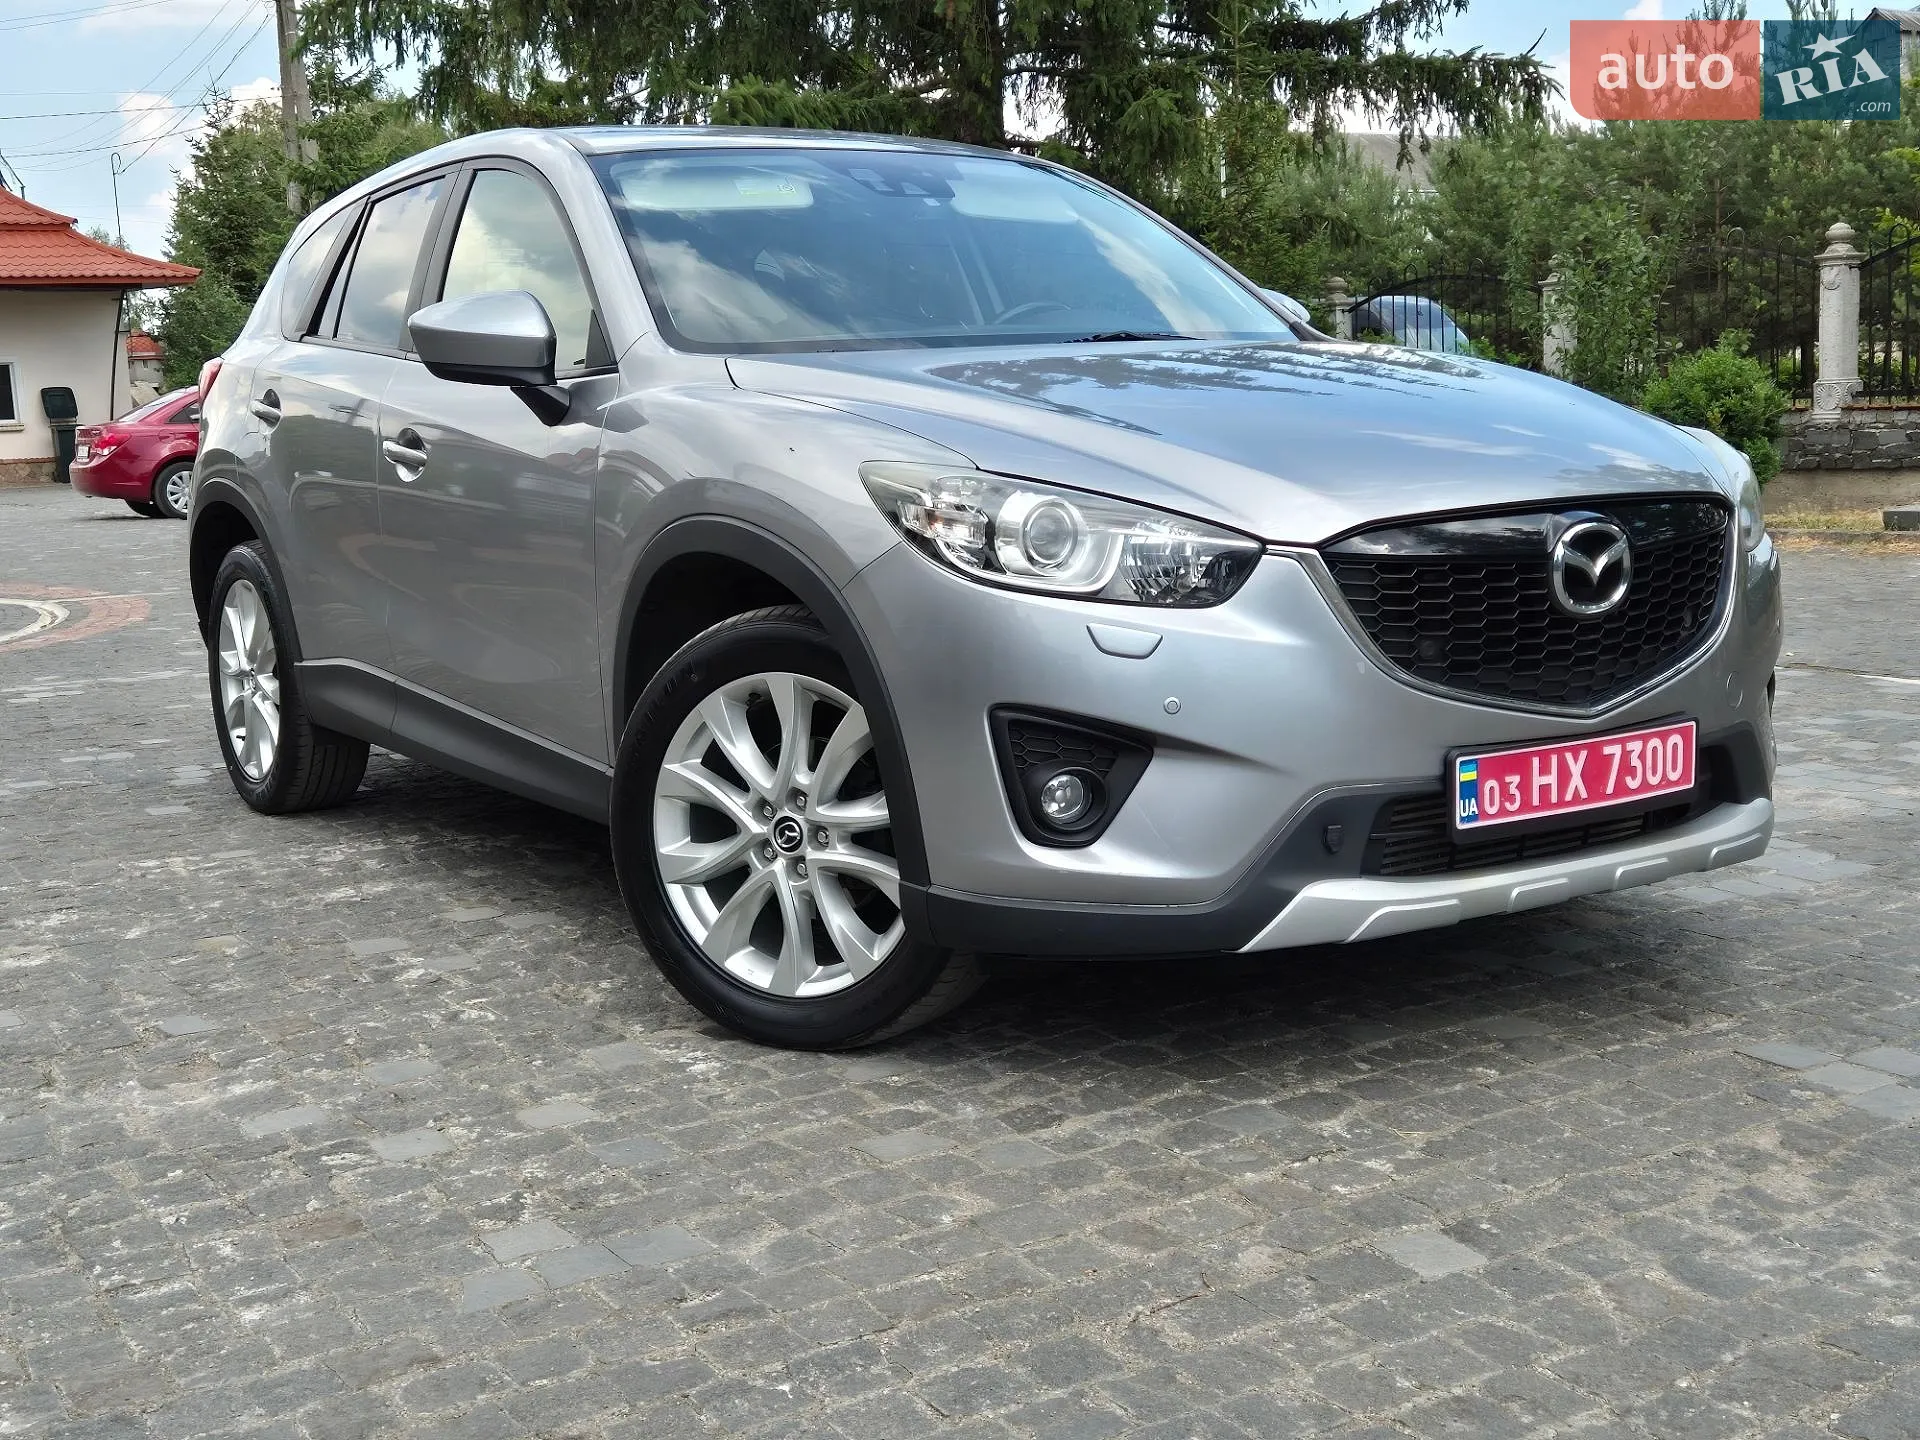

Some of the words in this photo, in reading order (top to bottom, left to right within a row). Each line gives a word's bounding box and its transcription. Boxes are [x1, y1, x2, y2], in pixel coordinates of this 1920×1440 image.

[1484, 775, 1521, 815] 03
[1532, 750, 1588, 806] HX
[1603, 734, 1684, 795] 7300
[1459, 798, 1478, 817] UA
